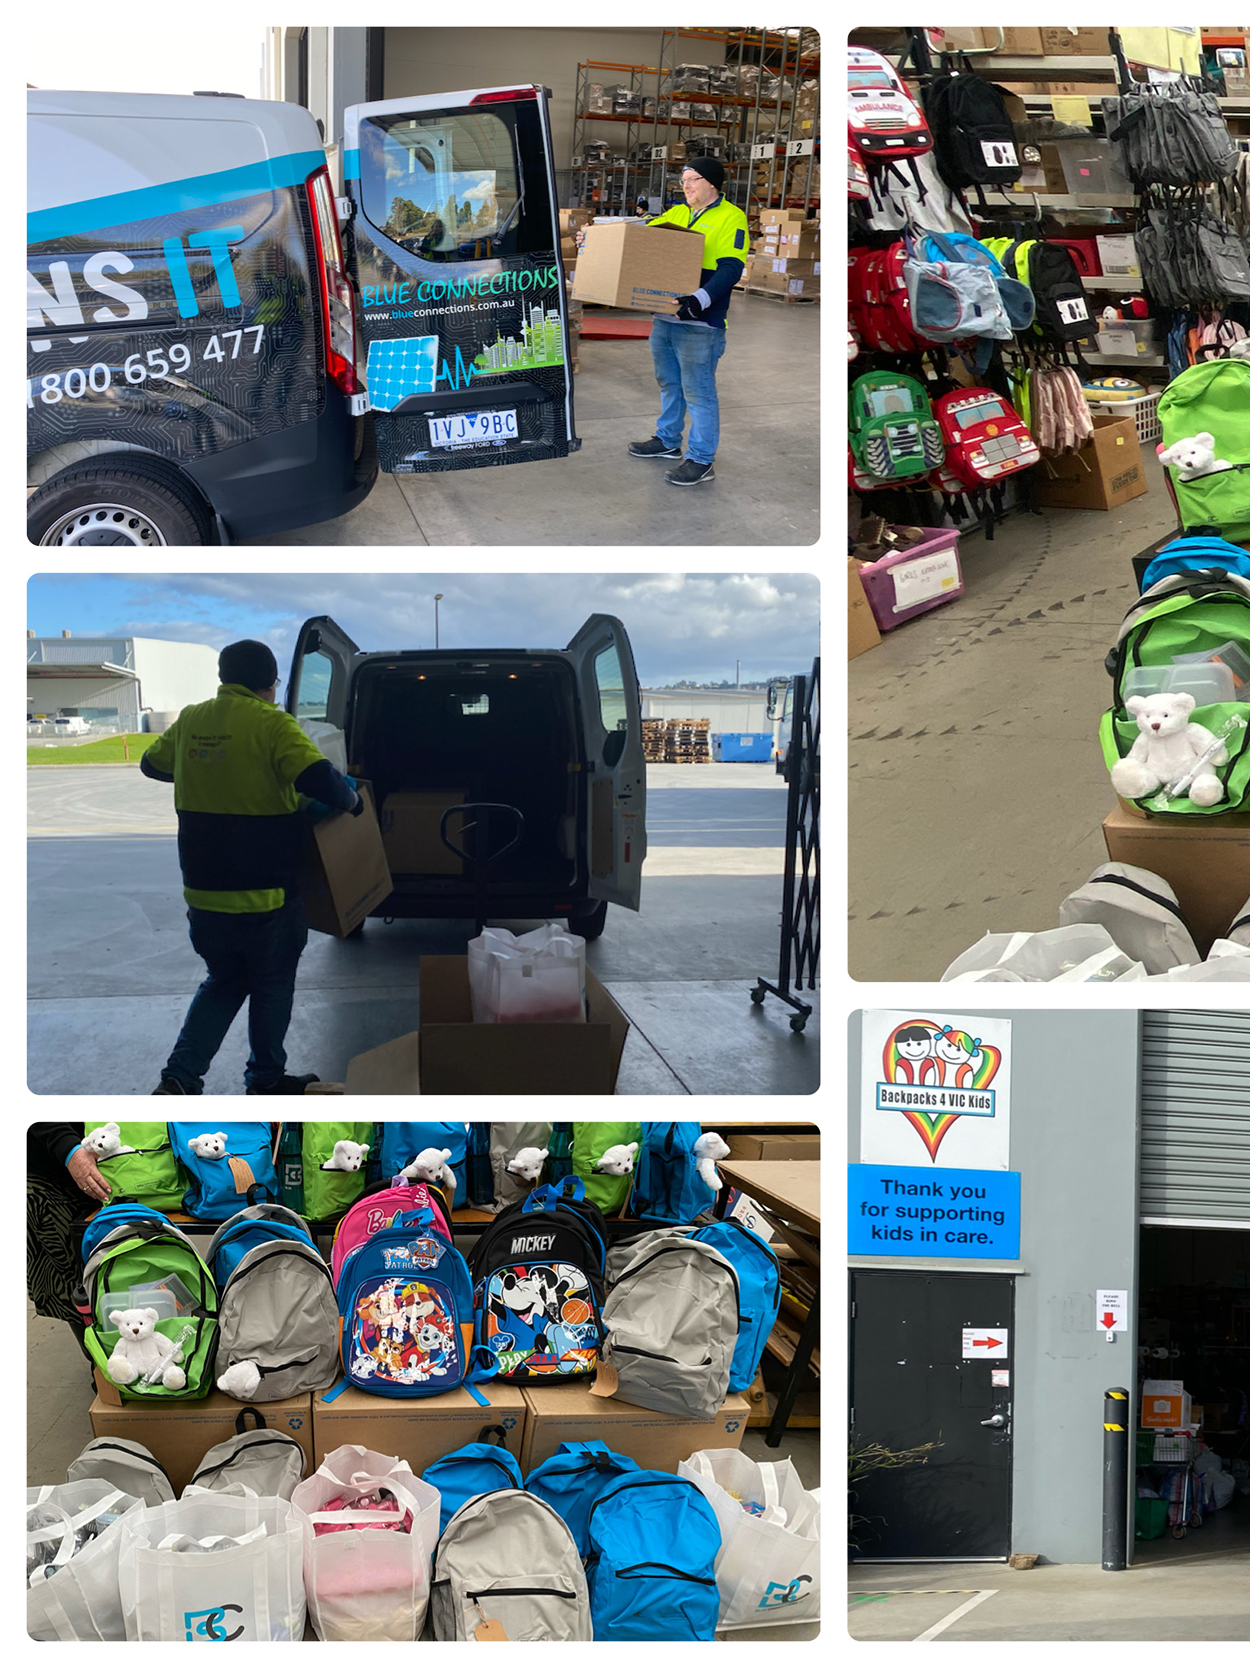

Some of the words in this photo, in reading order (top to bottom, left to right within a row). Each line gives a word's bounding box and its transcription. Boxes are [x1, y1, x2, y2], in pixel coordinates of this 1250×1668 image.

[855, 103, 904, 113] AMBULANCE
[760, 146, 764, 156] 1
[796, 143, 802, 154] 2
[162, 224, 246, 318] IT
[362, 282, 411, 308] BLUE
[417, 265, 559, 303] CONNECTIONS
[364, 299, 515, 321] www.blueconnections.com.au
[124, 343, 191, 384] 659
[203, 324, 264, 363] 477
[433, 419, 466, 440] 1VJ
[481, 413, 515, 435] 9BC
[881, 1089, 937, 1106] Backpacks
[940, 1093, 946, 1106] 4
[949, 1094, 965, 1107] VIC
[969, 1095, 990, 1109] Kids
[880, 1179, 944, 1197] Thank
[950, 1186, 986, 1200] you
[367, 1207, 416, 1235] Bare
[860, 1201, 889, 1217] for
[895, 1206, 1005, 1225] supporting
[511, 1235, 557, 1254] MICKEY
[872, 1225, 913, 1241] kids
[920, 1227, 937, 1242] in
[944, 1231, 994, 1245] care.
[408, 1241, 447, 1259] PAW
[498, 1350, 528, 1374] PLAY
[527, 1354, 560, 1364] ALL
